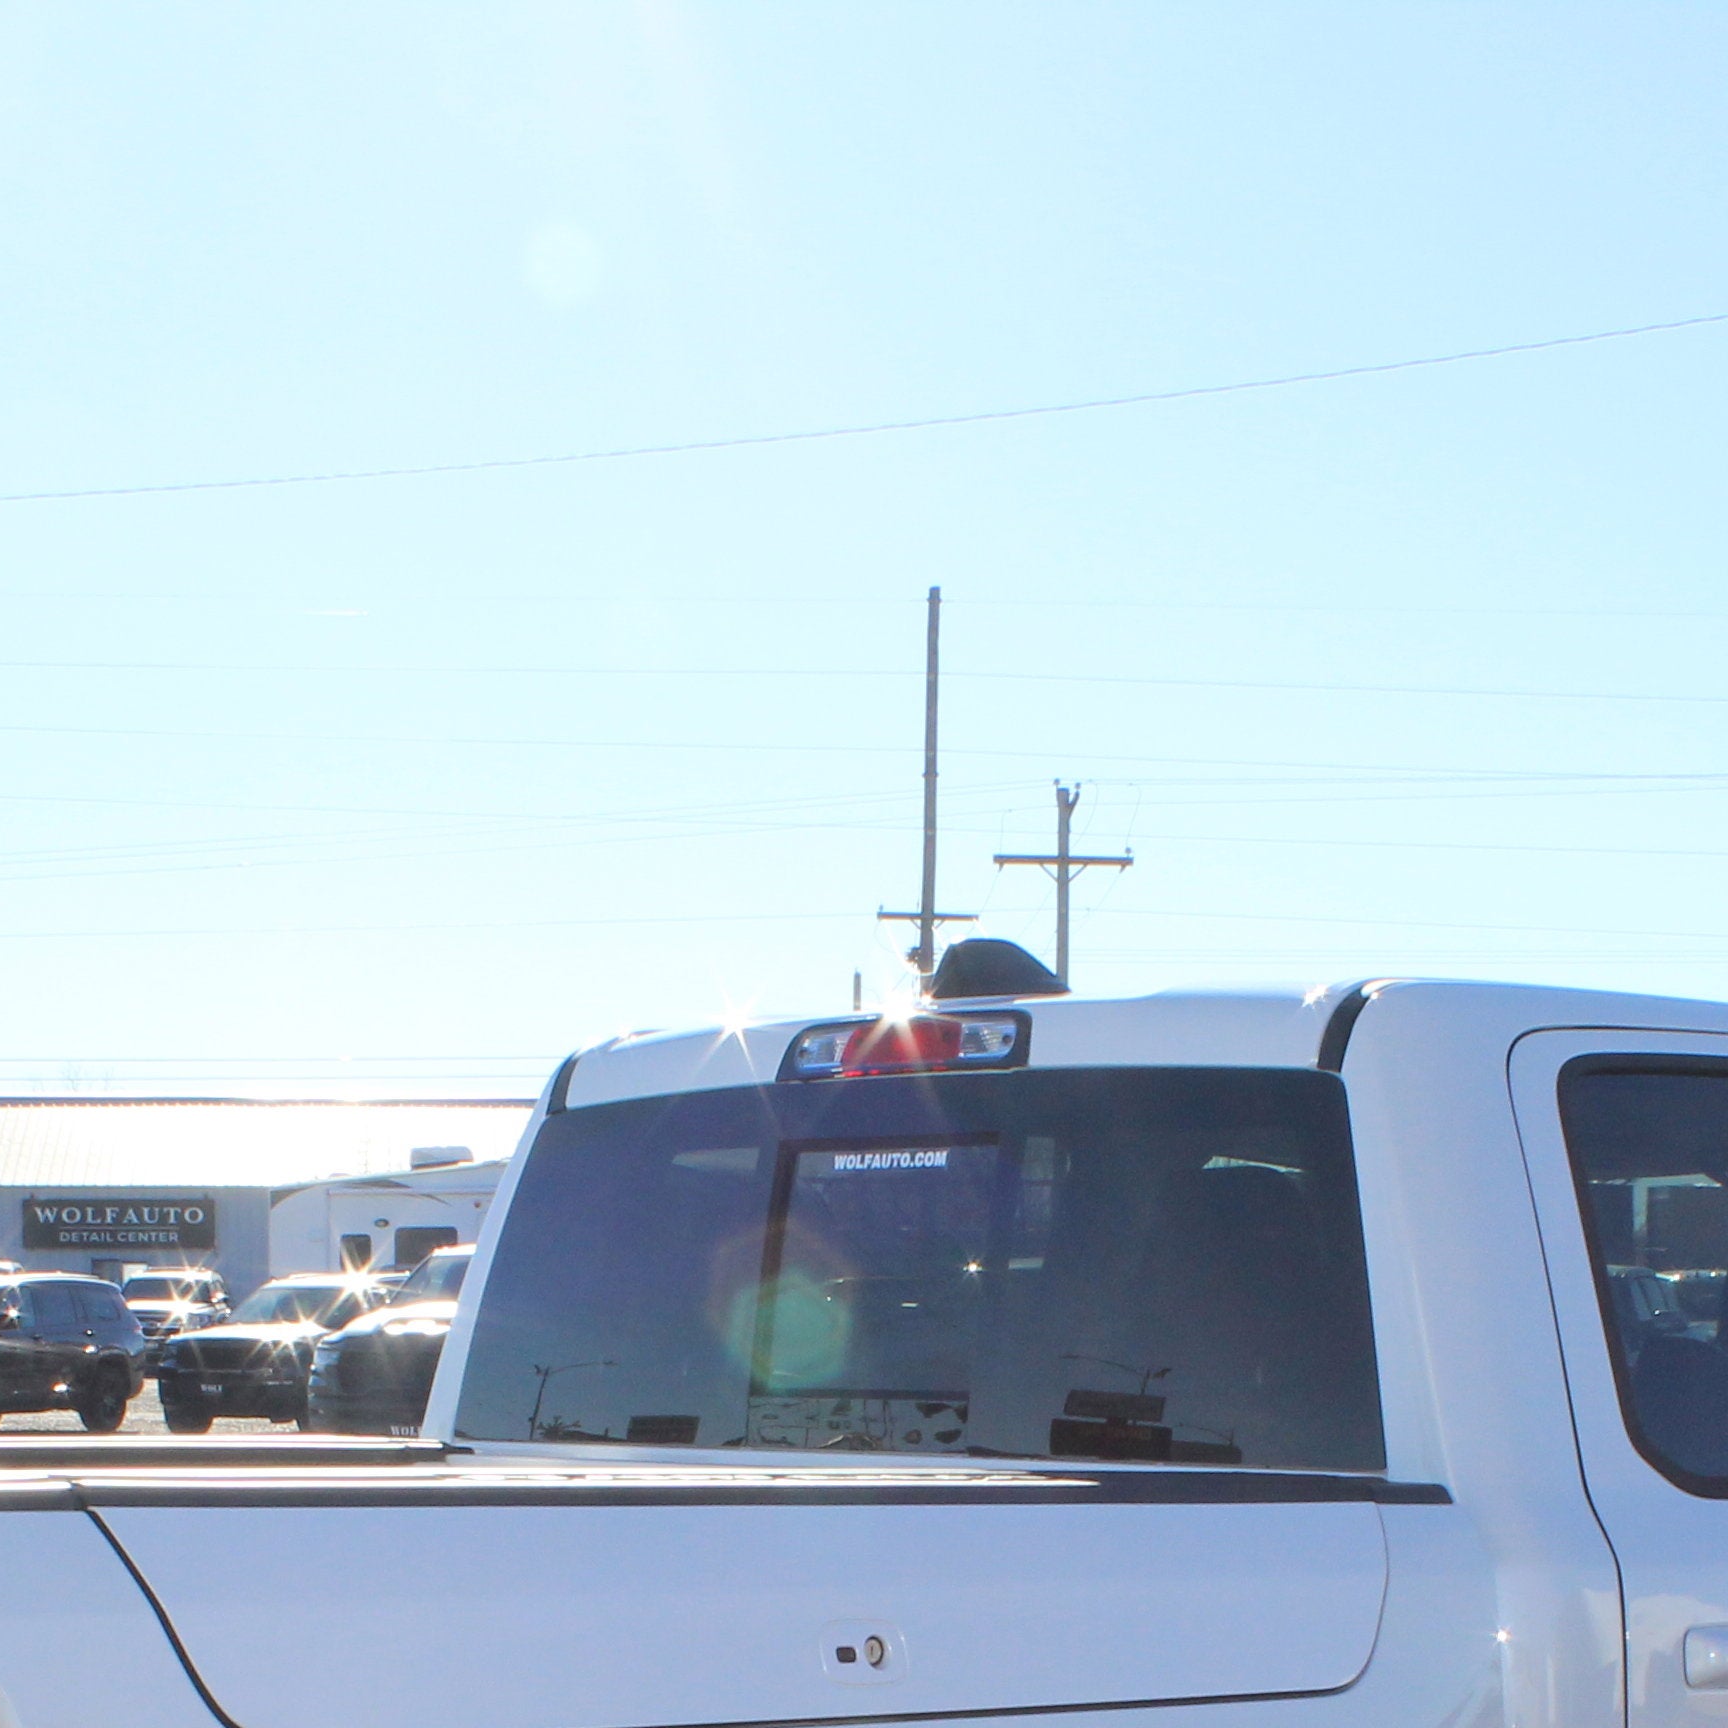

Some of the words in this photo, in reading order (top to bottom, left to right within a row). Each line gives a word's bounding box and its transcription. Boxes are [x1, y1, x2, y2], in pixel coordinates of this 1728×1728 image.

[834, 1150, 948, 1170] WOLFAUTO.COM
[34, 1206, 204, 1224] WOLFAUTO
[59, 1232, 113, 1242] DETAIL
[117, 1232, 178, 1242] CENTER
